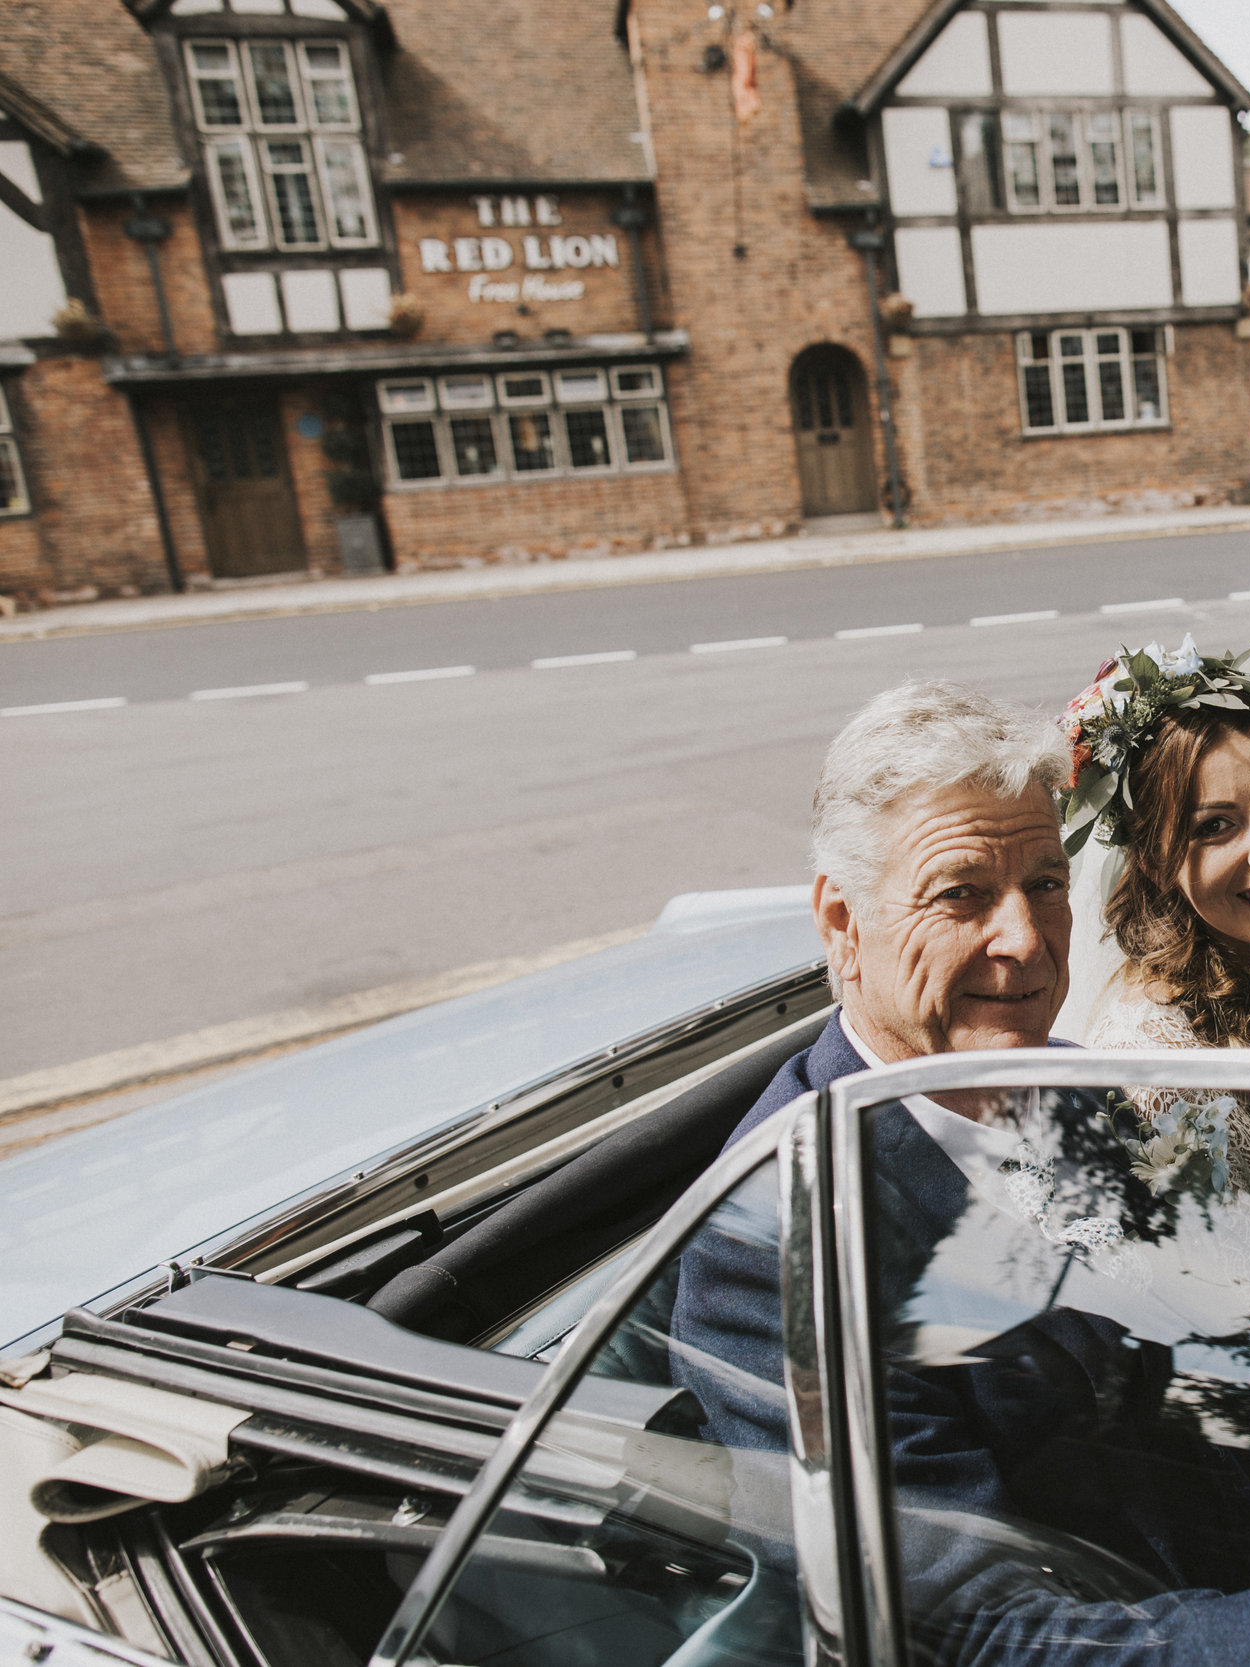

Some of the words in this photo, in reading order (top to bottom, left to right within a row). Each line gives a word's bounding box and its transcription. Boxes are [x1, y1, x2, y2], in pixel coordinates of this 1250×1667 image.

[472, 195, 562, 226] THE
[419, 237, 514, 273] RED
[522, 234, 619, 270] LION
